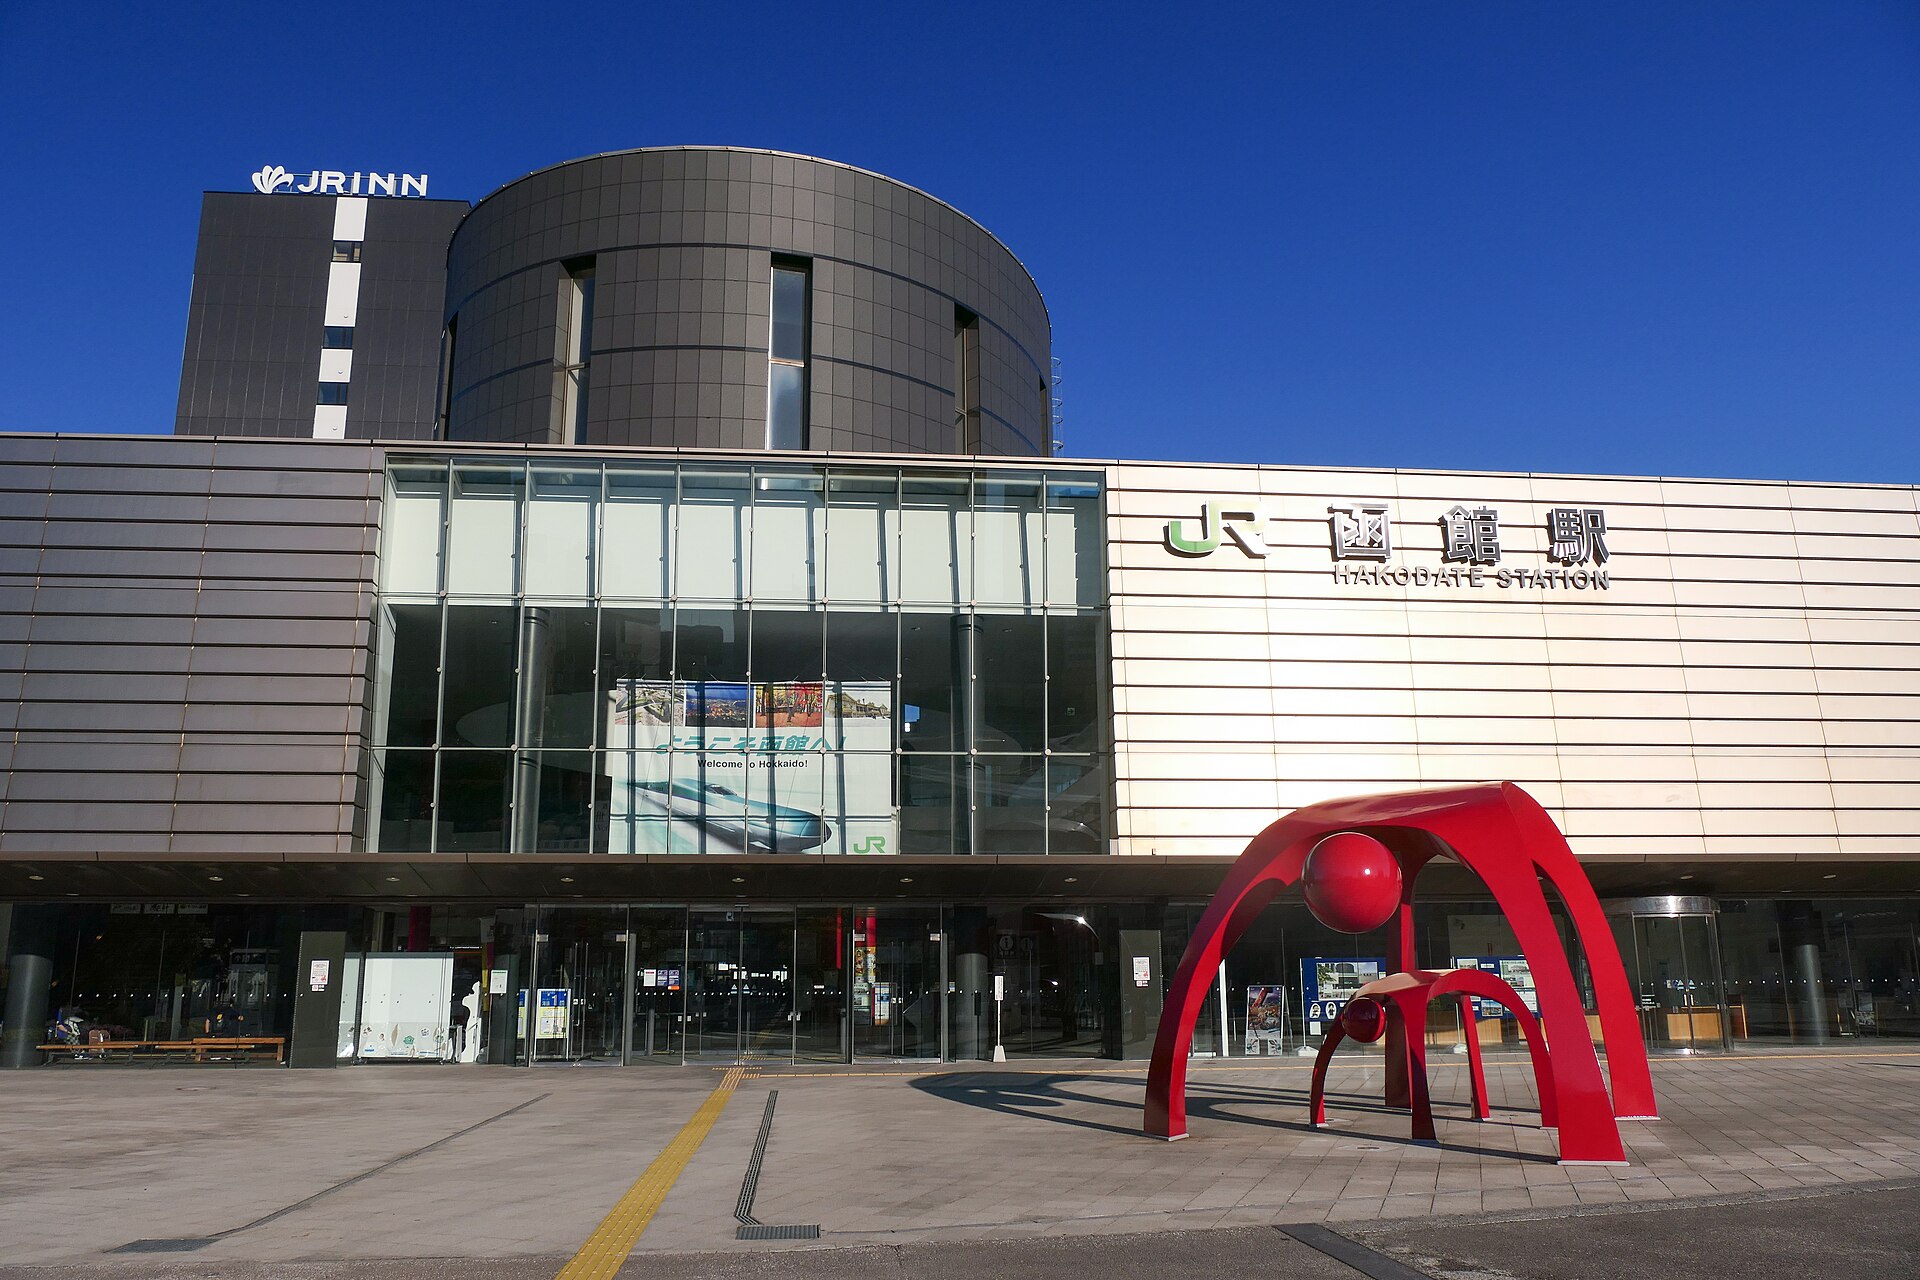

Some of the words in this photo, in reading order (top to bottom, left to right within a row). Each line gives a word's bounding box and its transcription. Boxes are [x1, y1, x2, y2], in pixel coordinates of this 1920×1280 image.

[1166, 499, 1270, 557] JR
[1330, 503, 1610, 564] 函館駅
[1334, 563, 1484, 588] HAKODATE
[1498, 567, 1611, 590] STATION
[697, 759, 743, 768] Welcome
[759, 759, 808, 769] Hokkaido!
[853, 836, 886, 854] JR
